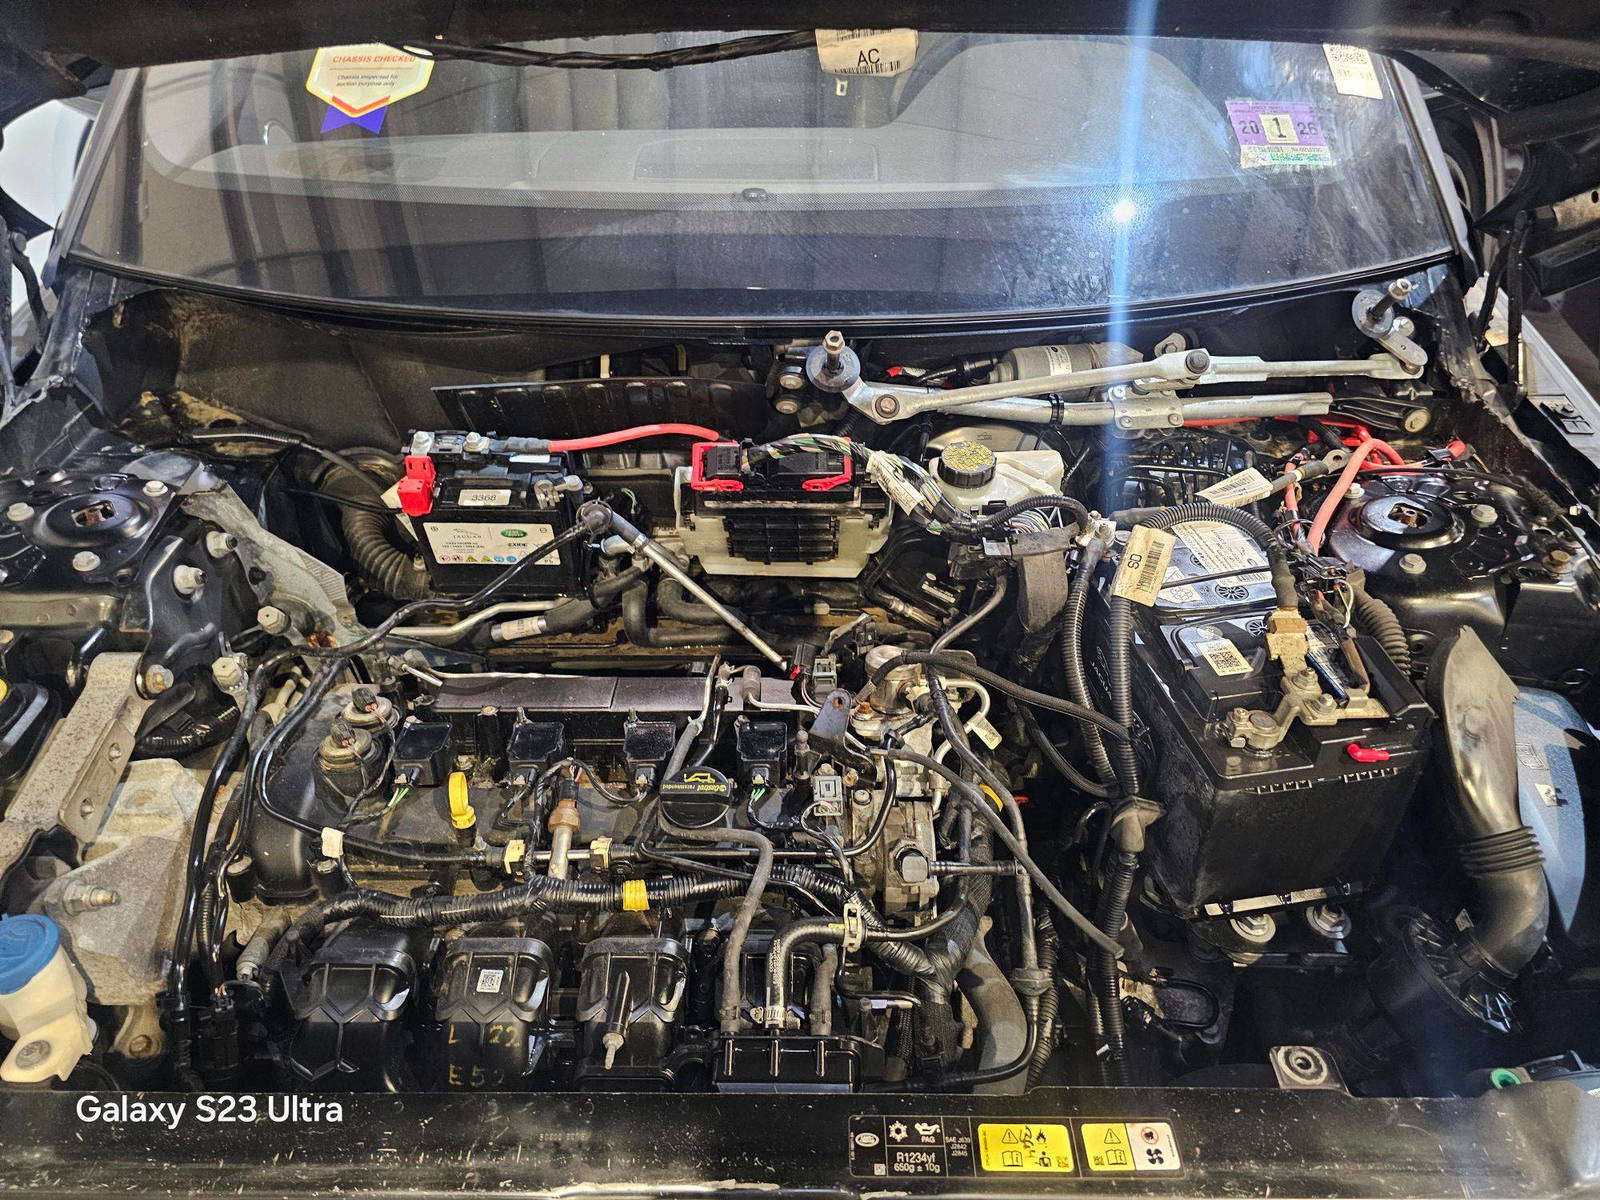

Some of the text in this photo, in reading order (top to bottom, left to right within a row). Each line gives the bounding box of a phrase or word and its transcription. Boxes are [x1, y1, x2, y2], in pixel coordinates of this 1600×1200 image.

[333, 54, 416, 63] CHASSIS CHECKED
[857, 48, 881, 67] AC
[1238, 116, 1319, 139] 20 1 26
[921, 1136, 936, 1144] PAG
[896, 1151, 936, 1165] R1234yf
[925, 1163, 941, 1174] 10g
